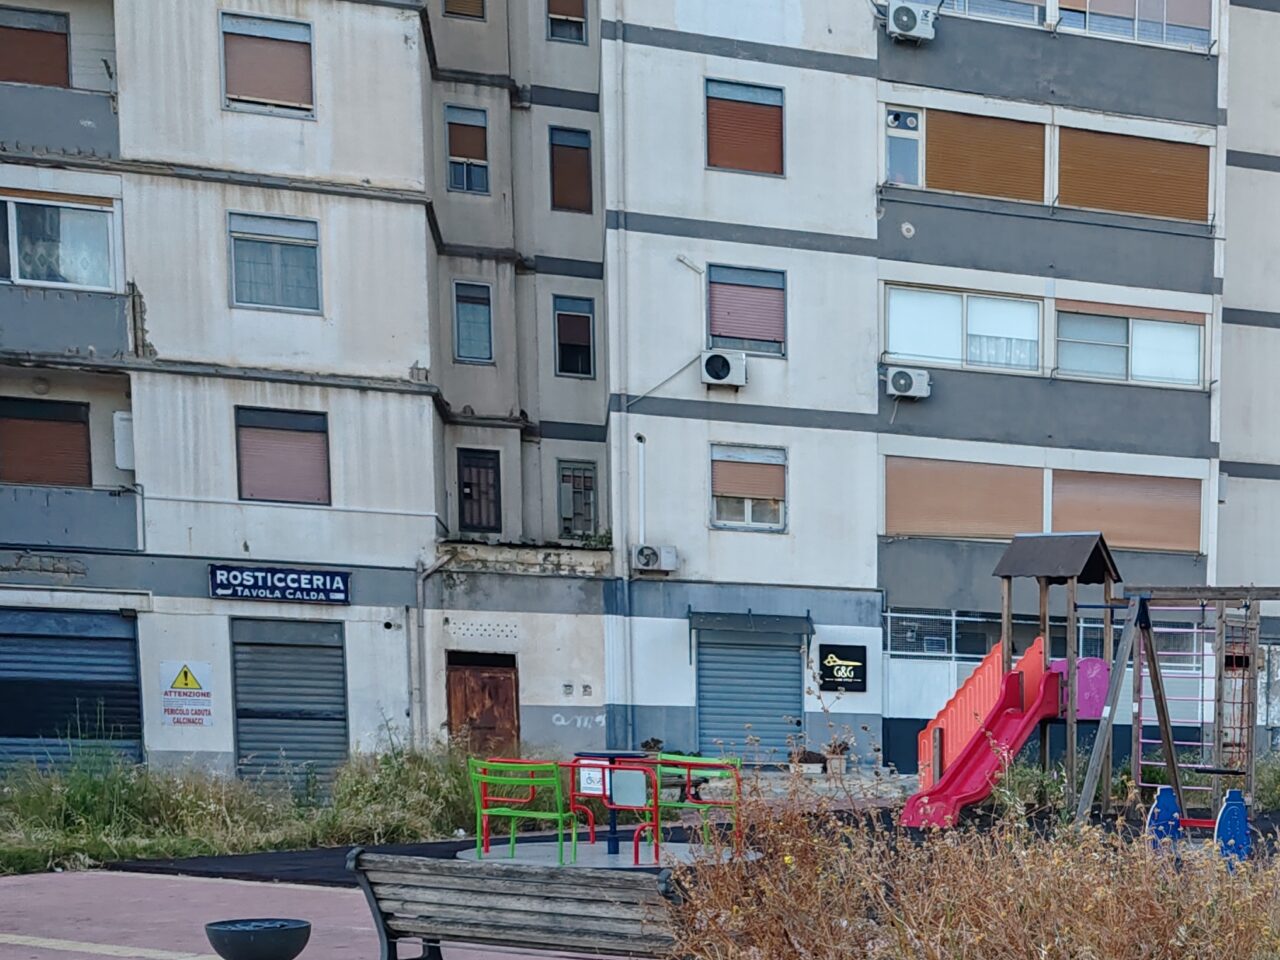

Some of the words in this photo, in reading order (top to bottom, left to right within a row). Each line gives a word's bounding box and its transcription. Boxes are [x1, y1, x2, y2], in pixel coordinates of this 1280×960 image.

[216, 570, 345, 590] ROSTICCERIA
[235, 587, 281, 598] TAVOLA
[285, 589, 326, 600] CALDA
[833, 666, 854, 678] G&G
[163, 690, 212, 698] ATTENZIONE
[163, 708, 189, 716] PERICOLO
[190, 708, 212, 716] CADUTA
[172, 717, 204, 726] CALCINACCI
